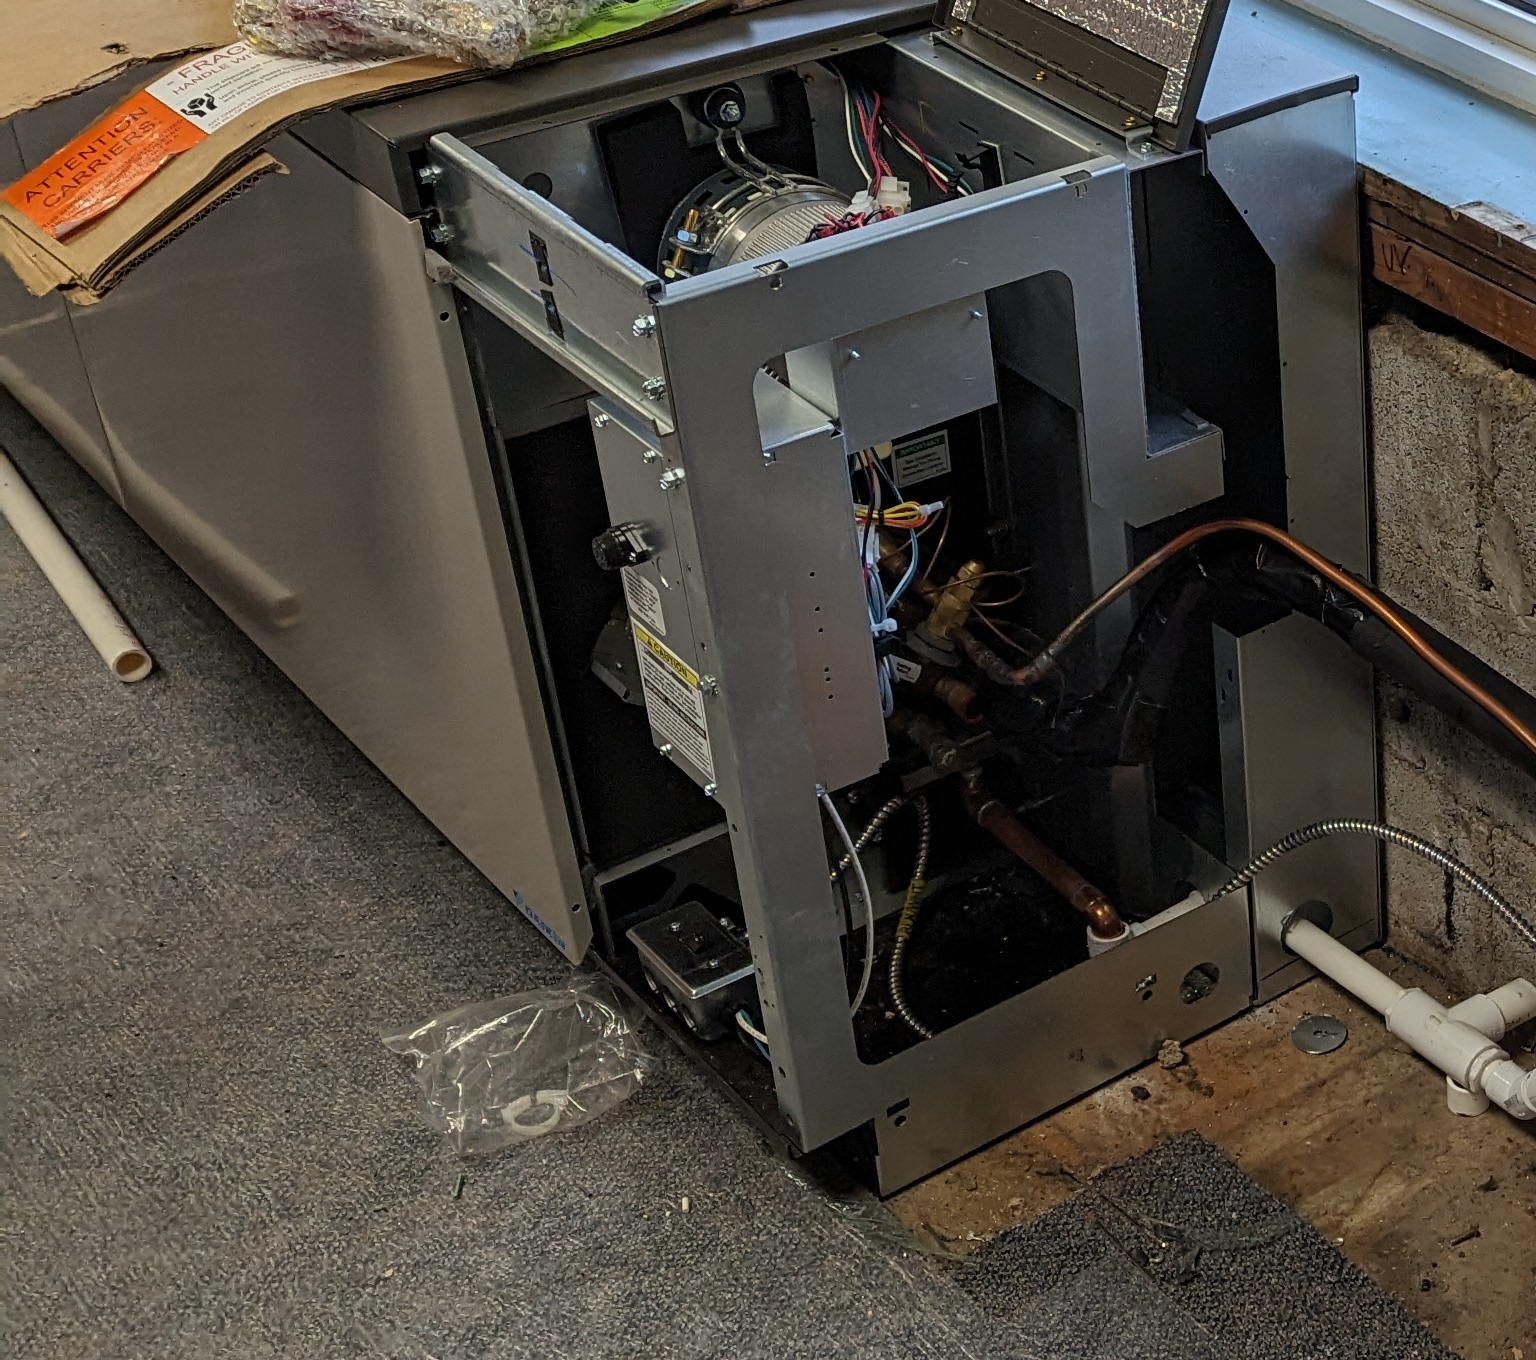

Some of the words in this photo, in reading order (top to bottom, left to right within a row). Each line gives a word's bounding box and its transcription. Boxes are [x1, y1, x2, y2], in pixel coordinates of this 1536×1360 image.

[172, 63, 231, 96] HANDLE
[25, 106, 149, 204] ATTENTION
[42, 117, 163, 208] CARRIERS:
